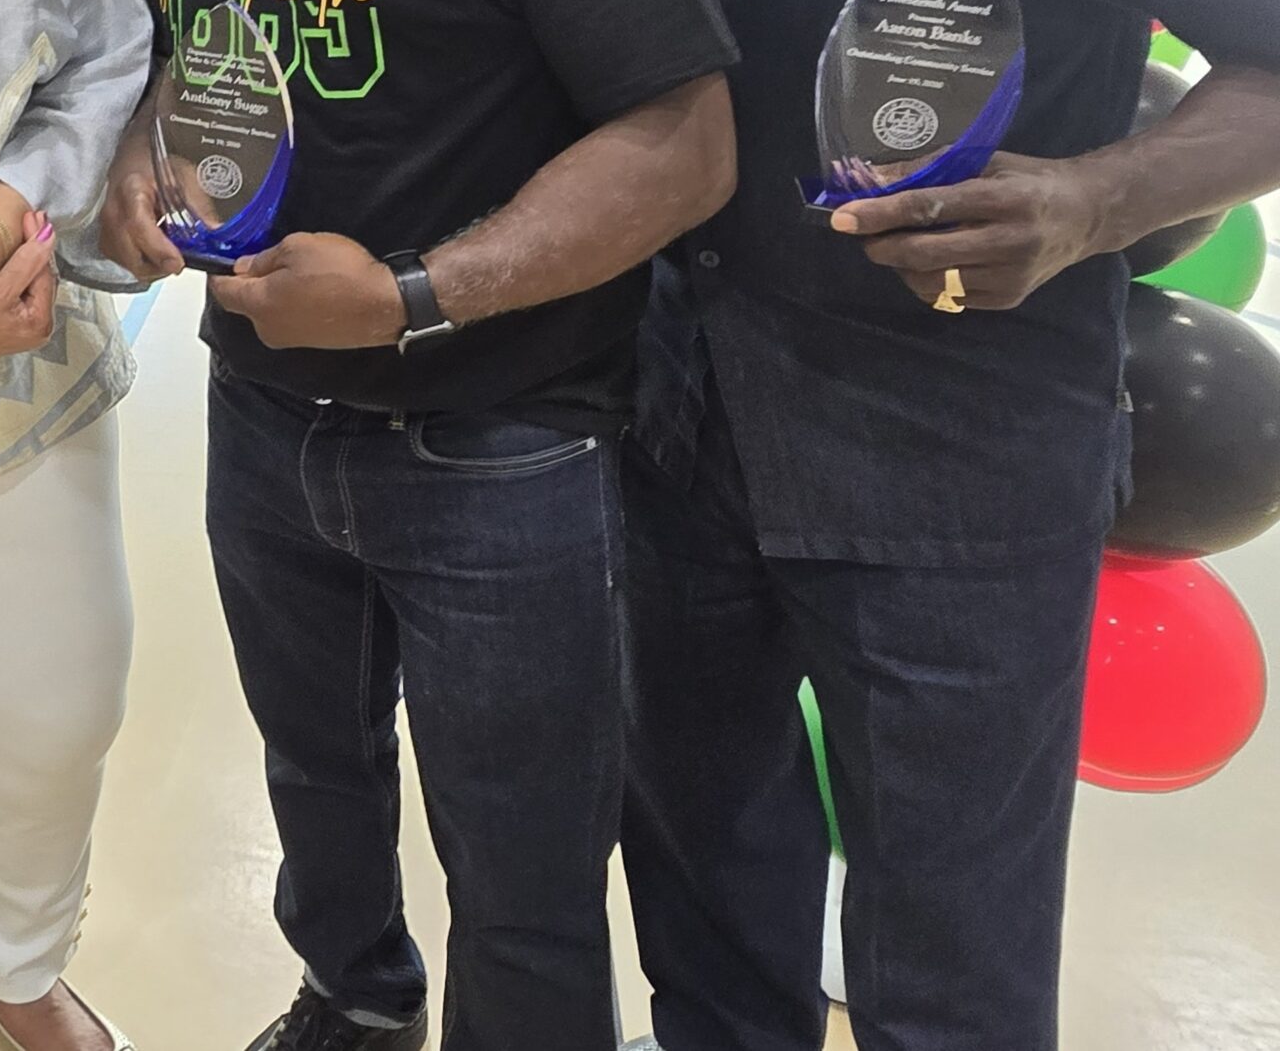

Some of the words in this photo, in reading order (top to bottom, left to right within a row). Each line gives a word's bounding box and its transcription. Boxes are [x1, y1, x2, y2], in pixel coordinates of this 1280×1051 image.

[947, 0, 993, 17] Award
[874, 19, 927, 38] Aaron
[929, 26, 983, 46] Banks
[846, 47, 903, 64] Outstanding
[903, 55, 959, 72] Community
[180, 89, 232, 110] Anthony
